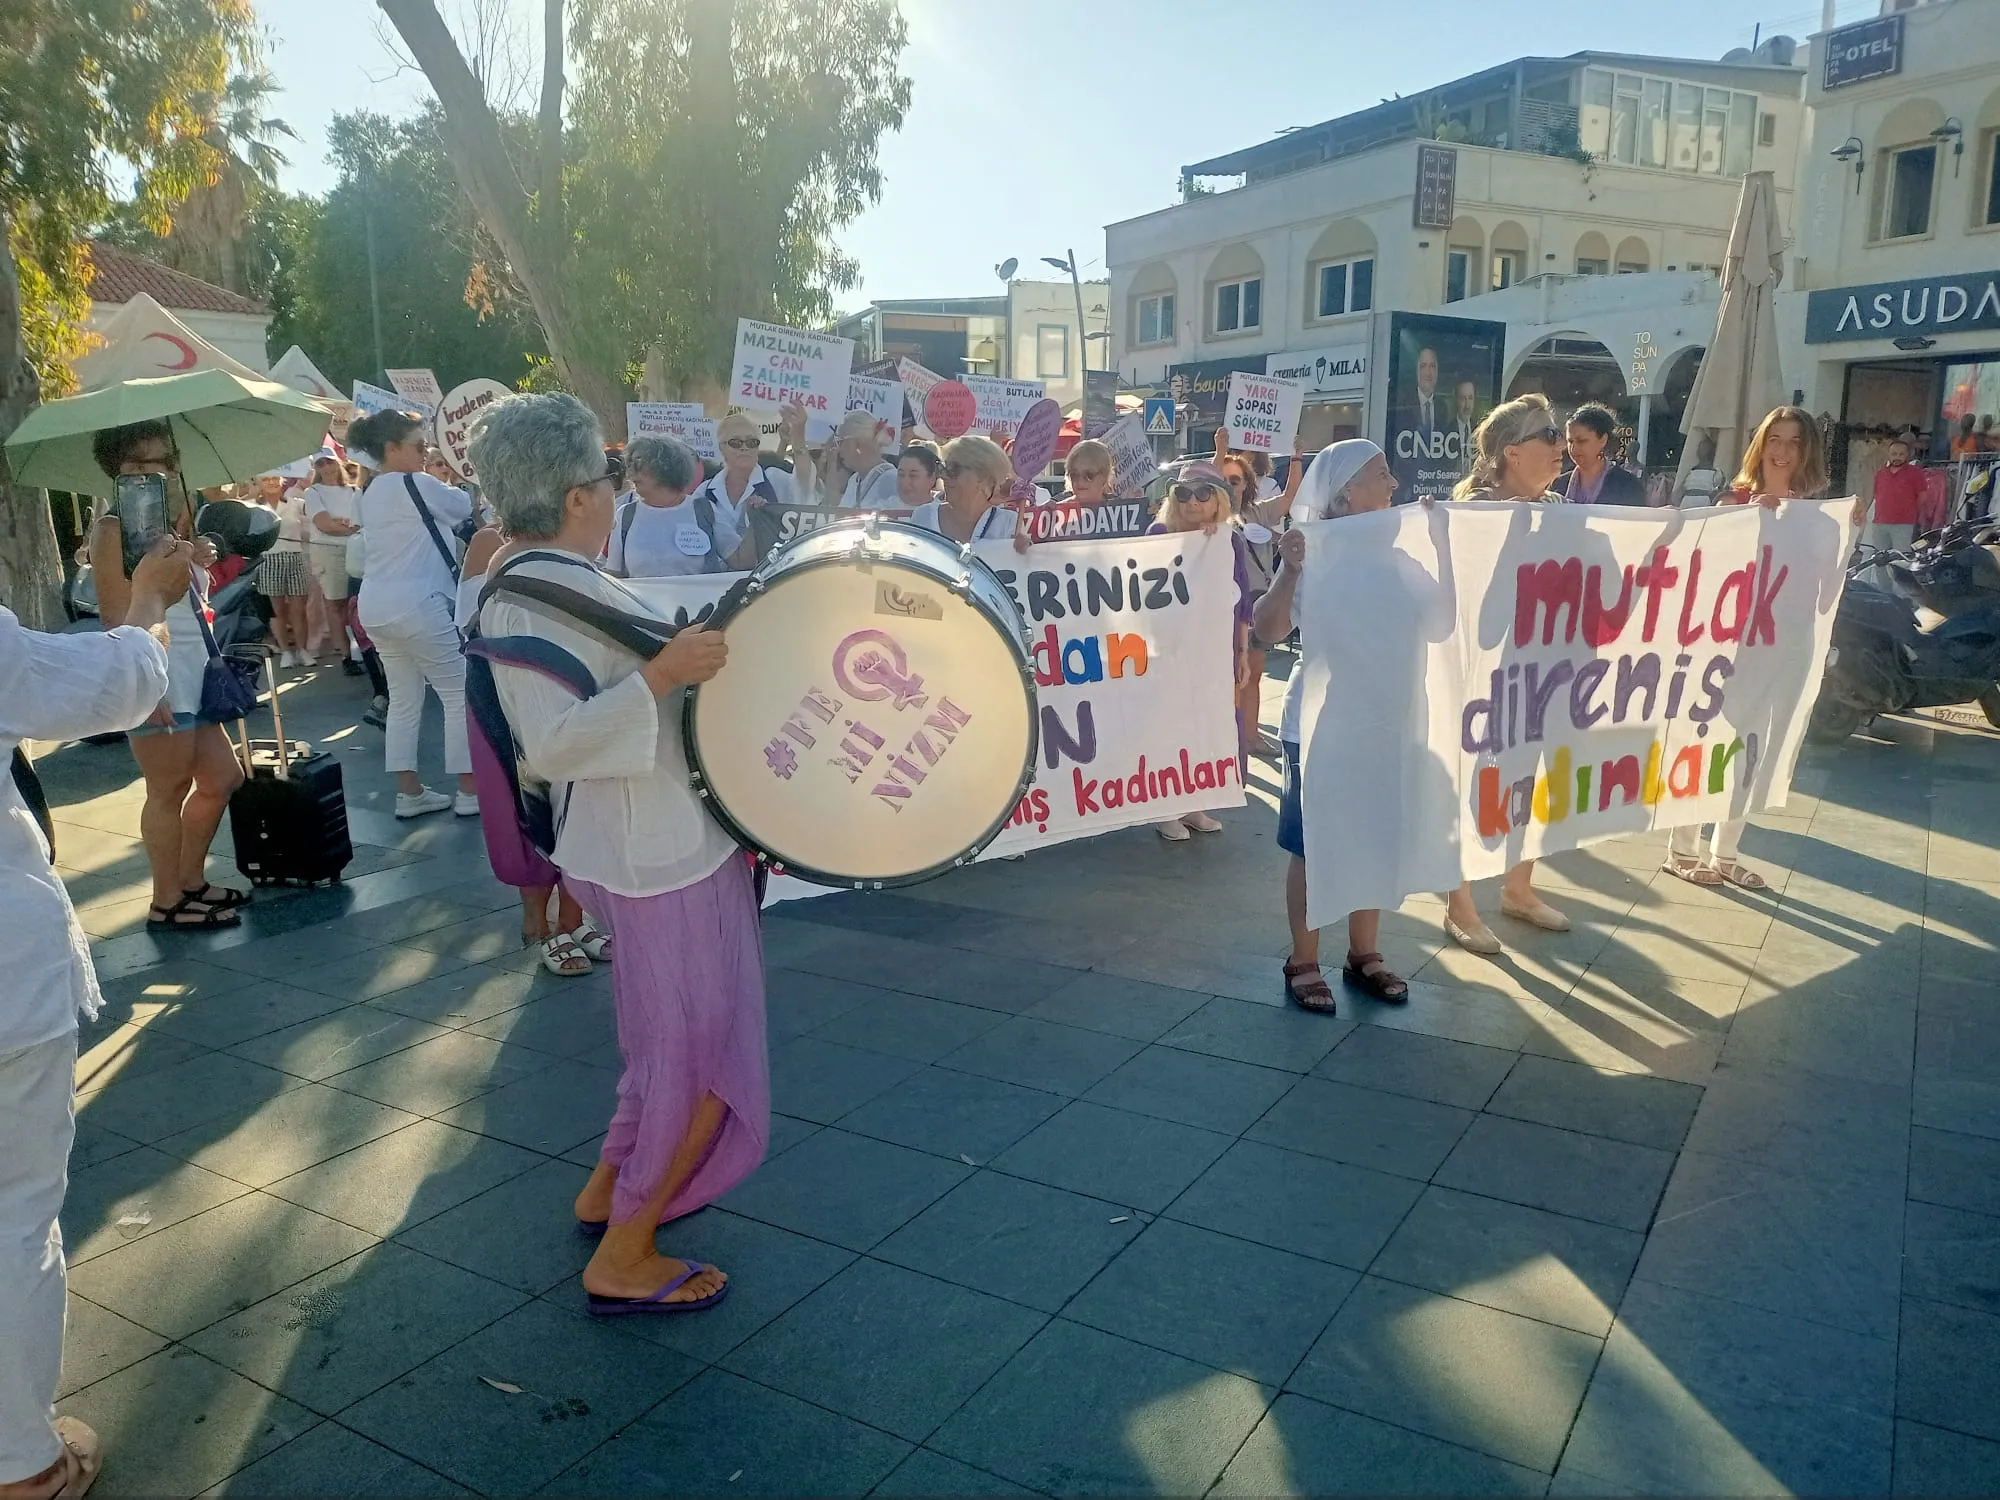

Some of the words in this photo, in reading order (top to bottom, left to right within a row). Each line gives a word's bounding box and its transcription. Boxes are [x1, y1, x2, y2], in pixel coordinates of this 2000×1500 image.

[1846, 37, 1892, 61] OTEL
[749, 322, 777, 333] MUTLAK
[778, 327, 805, 339] DİRENİŞ
[807, 333, 843, 345] KADINLARI
[1634, 331, 1651, 344] TO
[743, 331, 823, 360] MAZLUMA
[1633, 346, 1658, 359] SUN
[769, 354, 804, 371] CAN
[1632, 361, 1647, 373] PA
[742, 364, 811, 389] ZALİME
[1273, 365, 1311, 379] cremeria
[1245, 383, 1278, 400] YARGI
[1631, 376, 1646, 392] ŞA
[741, 382, 828, 410] ZÜLFİKAR
[1006, 387, 1042, 399] BUTLAN
[1235, 398, 1276, 415] SOPASI
[1233, 415, 1280, 432] SÖKMEZ
[1244, 431, 1271, 447] BİZE
[1417, 470, 1435, 480] Spor
[1413, 483, 1437, 496] Dünya
[1037, 503, 1140, 539] ORADAYIZ
[1513, 545, 1789, 649] mutlak
[1461, 652, 1736, 756] direniş
[1478, 732, 1759, 838] kadınları
